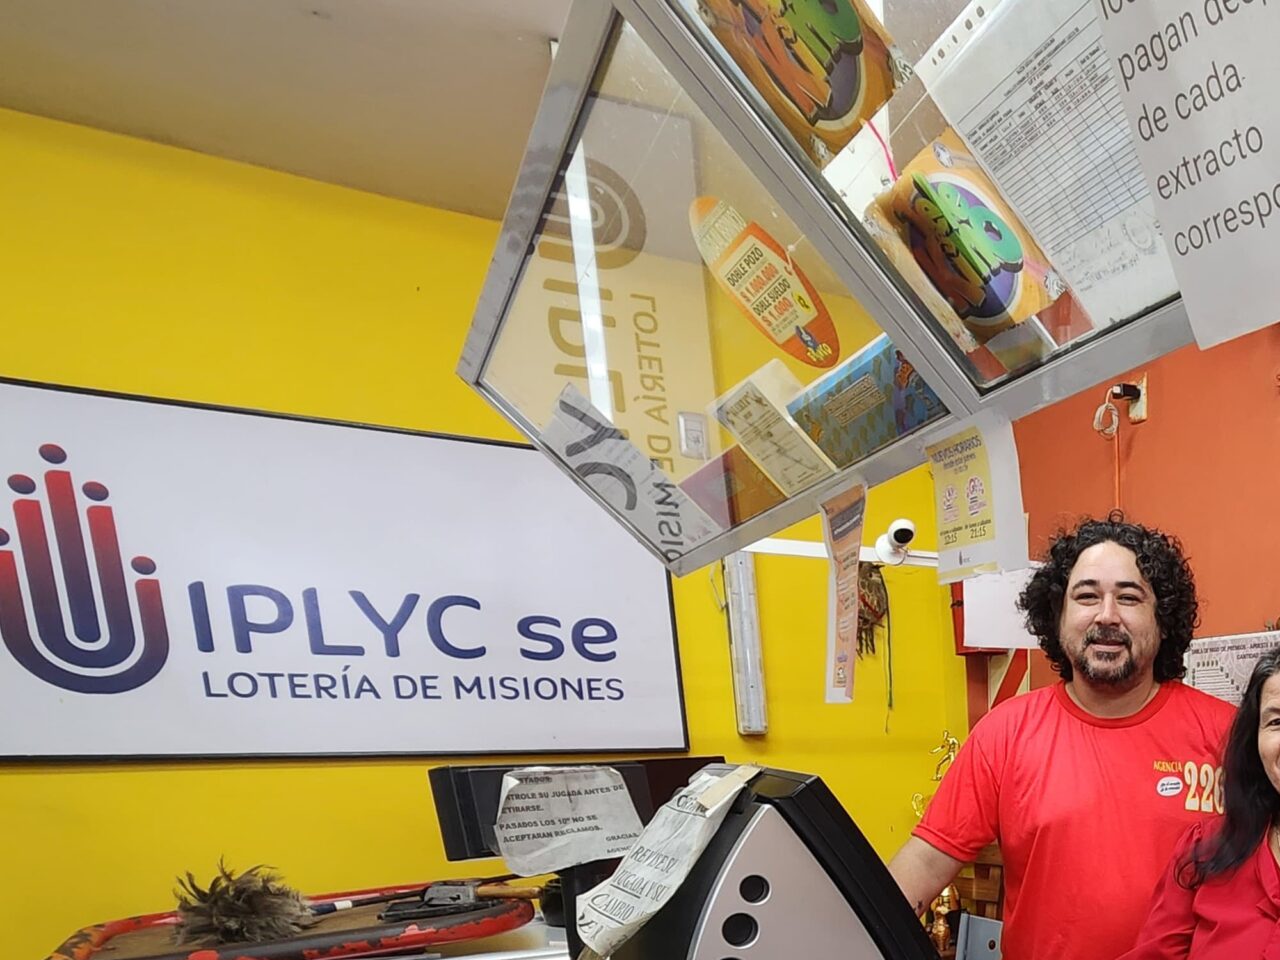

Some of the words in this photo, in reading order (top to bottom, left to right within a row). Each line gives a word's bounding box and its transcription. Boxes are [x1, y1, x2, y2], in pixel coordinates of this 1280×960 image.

[1117, 12, 1198, 91] pagan
[1137, 104, 1169, 141] de
[1174, 61, 1243, 121] cada
[1156, 125, 1264, 200] extracto
[726, 264, 748, 287] DOBLE
[187, 580, 487, 659] IPLYC
[516, 614, 619, 662] se
[202, 664, 381, 700] LOTERÍA
[394, 674, 442, 700] DE
[455, 675, 625, 702] MISIONES
[1153, 760, 1183, 773] AGENCIA
[537, 791, 549, 799] SU
[551, 789, 583, 798] JUGADA
[584, 786, 611, 796] ANTES
[613, 784, 625, 792] DE
[499, 819, 539, 831] PASADOS
[539, 819, 556, 827] LOS
[586, 814, 598, 822] SE
[503, 831, 553, 844] ACEPTARAN
